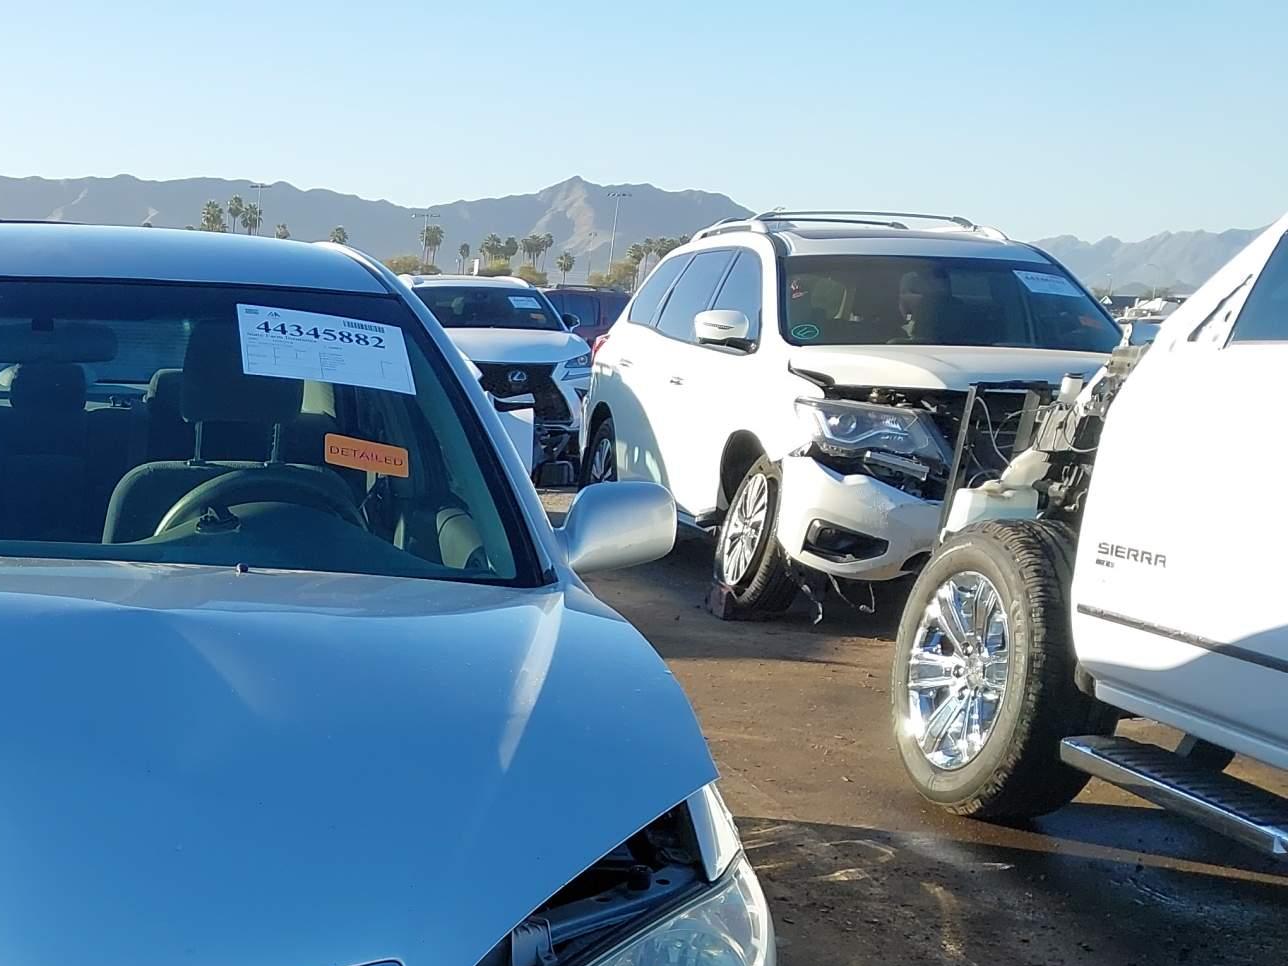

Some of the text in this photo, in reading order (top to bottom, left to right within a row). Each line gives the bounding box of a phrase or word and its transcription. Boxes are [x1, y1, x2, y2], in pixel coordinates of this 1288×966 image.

[256, 320, 386, 349] 44345882
[329, 445, 404, 467] DETAILED
[1097, 542, 1167, 568] SIERRA
